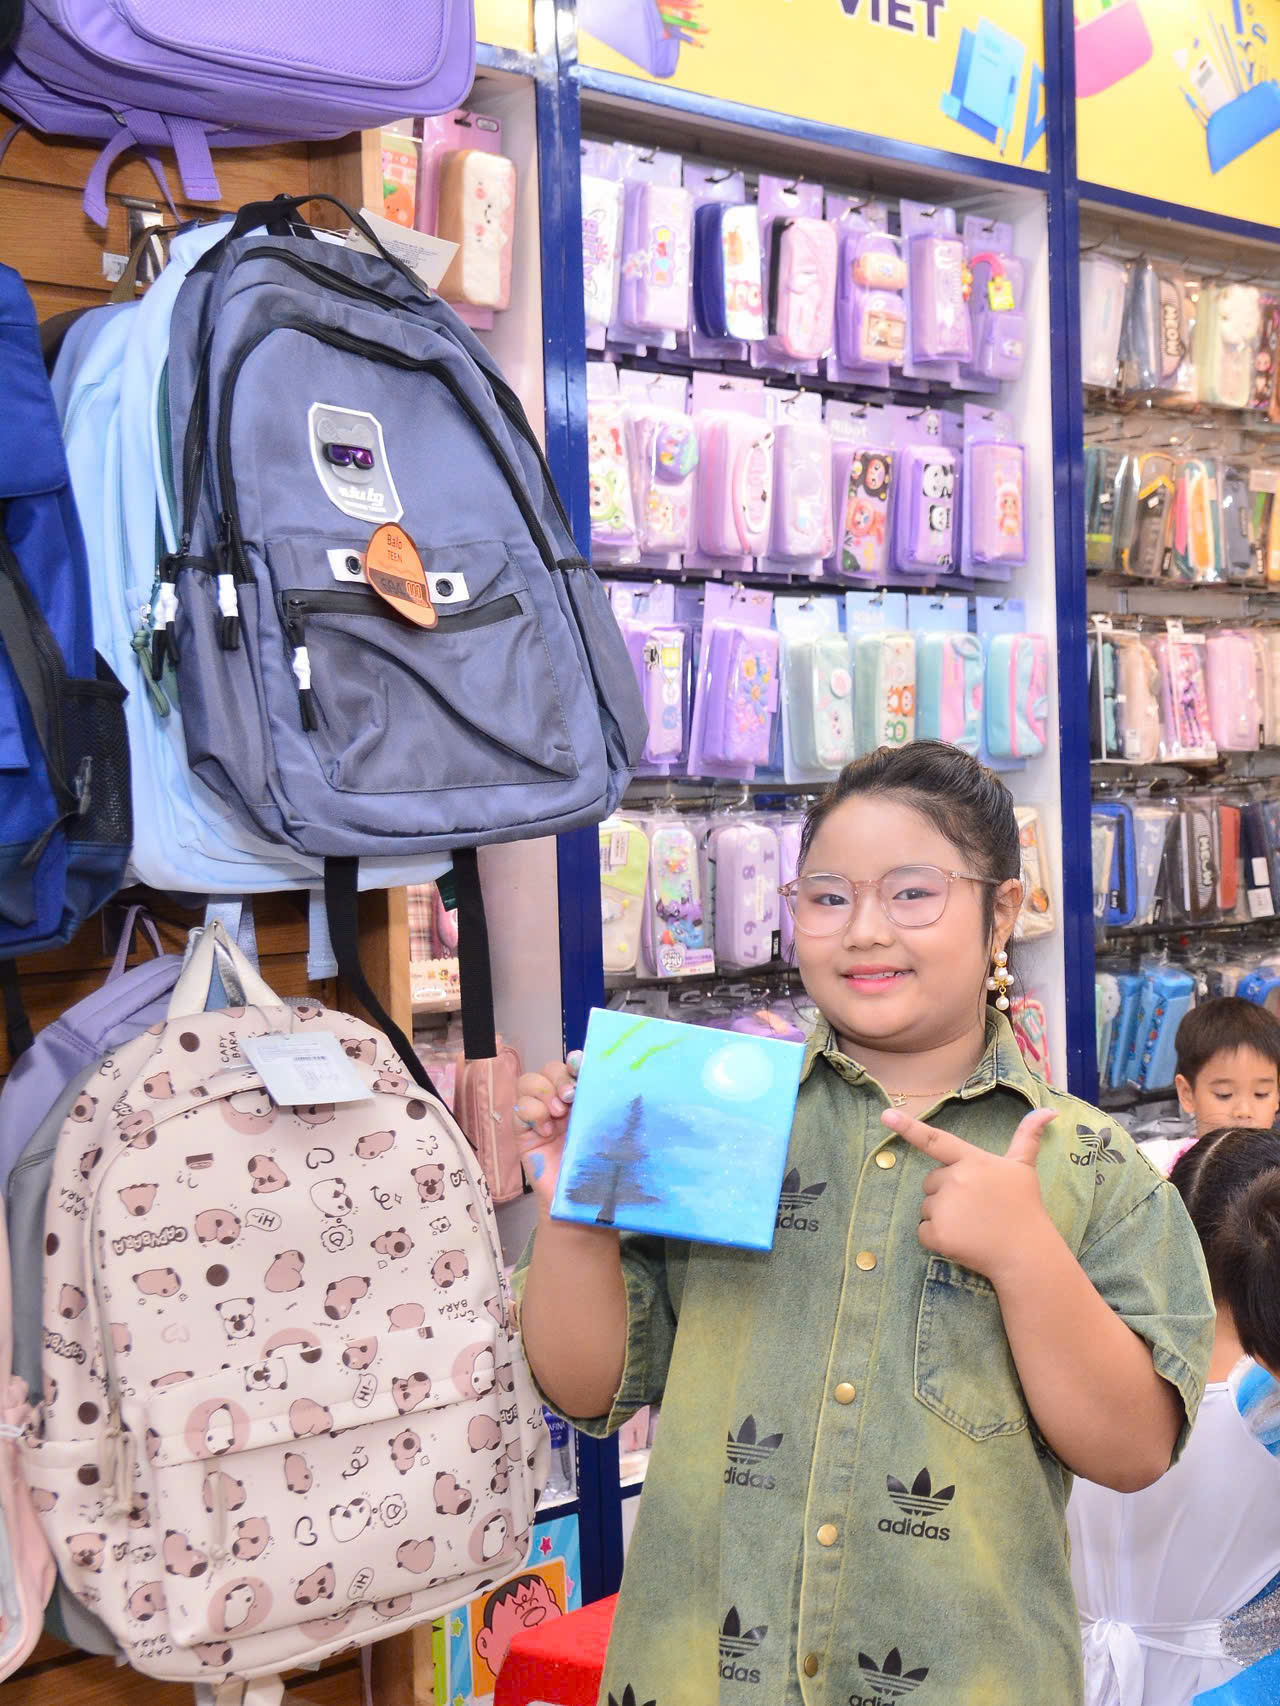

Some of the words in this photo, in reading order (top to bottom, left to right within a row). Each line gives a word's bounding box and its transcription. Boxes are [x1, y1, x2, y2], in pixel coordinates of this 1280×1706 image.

[219, 1035, 230, 1063] CAPY
[229, 1031, 241, 1059] BARA
[776, 1213, 819, 1232] idas
[112, 1225, 188, 1256] CAPYBARA
[724, 1467, 776, 1490] didas
[878, 1518, 951, 1541] adidas
[719, 1662, 761, 1684] idas
